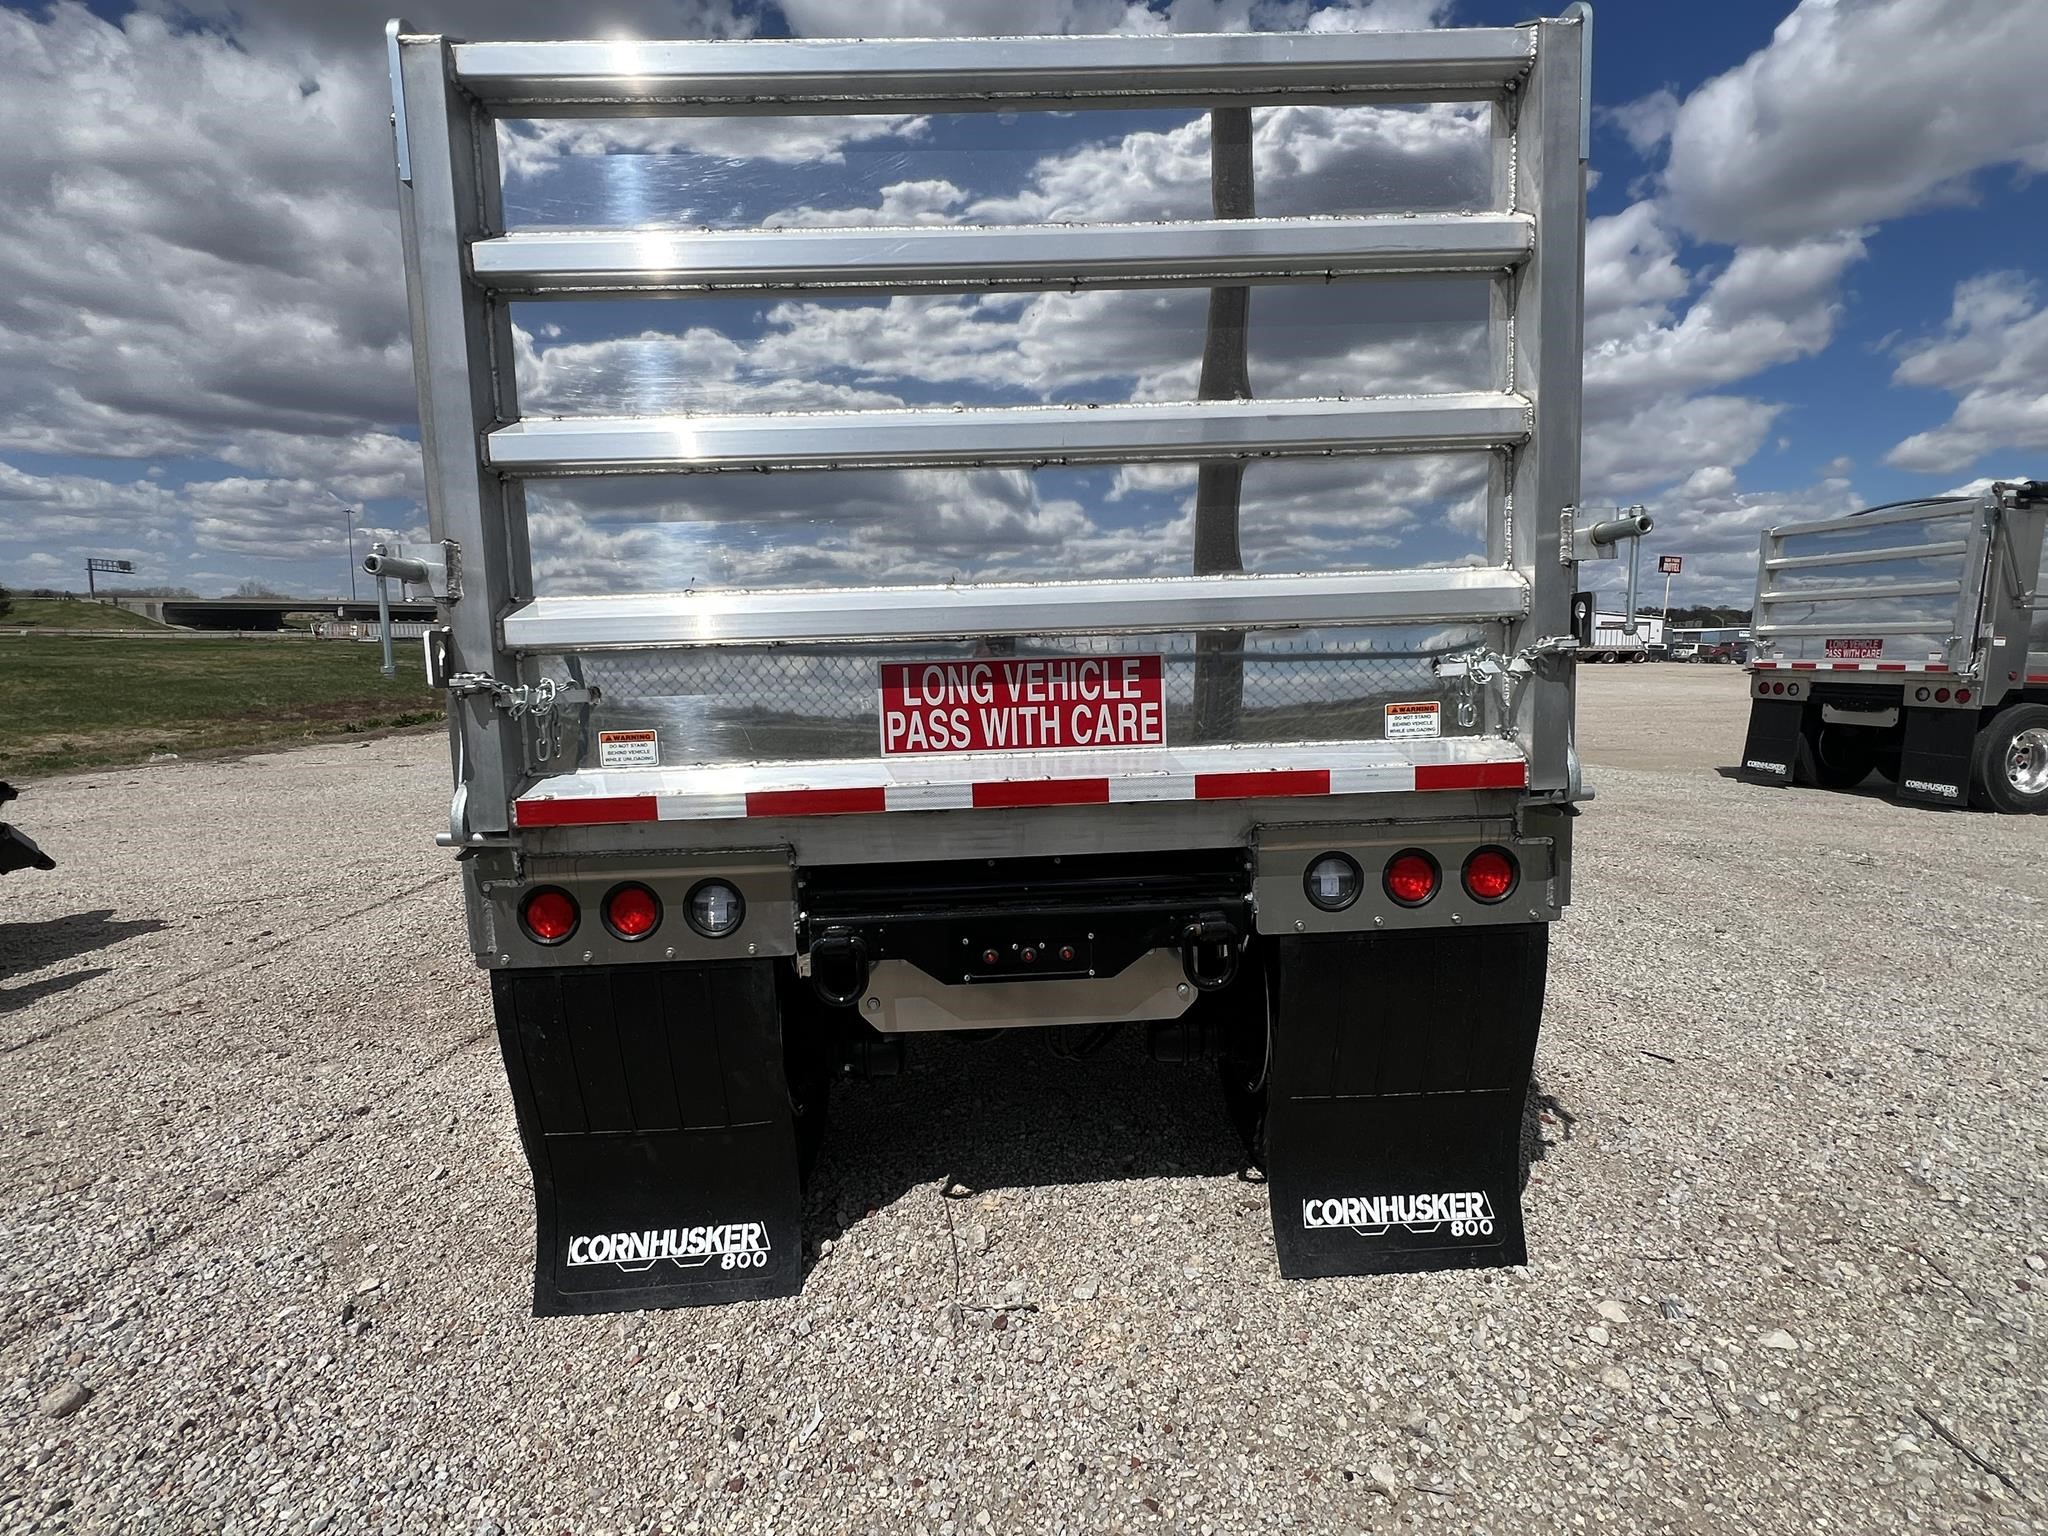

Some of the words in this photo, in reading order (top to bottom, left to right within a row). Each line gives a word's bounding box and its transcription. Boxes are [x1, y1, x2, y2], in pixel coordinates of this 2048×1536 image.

[1825, 648, 1842, 658] PASS
[1843, 648, 1860, 658] WITH
[1861, 648, 1880, 658] CARE
[1829, 640, 1848, 649] LONG
[1850, 640, 1879, 649] VEHICLE
[902, 663, 994, 706] LONG
[1003, 660, 1142, 702] VEHICLE
[1399, 705, 1435, 713] WARNING
[887, 708, 971, 750] PASS
[980, 705, 1061, 747] WITH
[1071, 702, 1160, 745] CARE
[1905, 779, 1957, 793] CORNHUSKER
[1305, 1192, 1484, 1226] CORNHUSKER
[1450, 1219, 1494, 1237] 800
[570, 1222, 763, 1264] CORNHUSKER
[720, 1250, 768, 1271] 800
